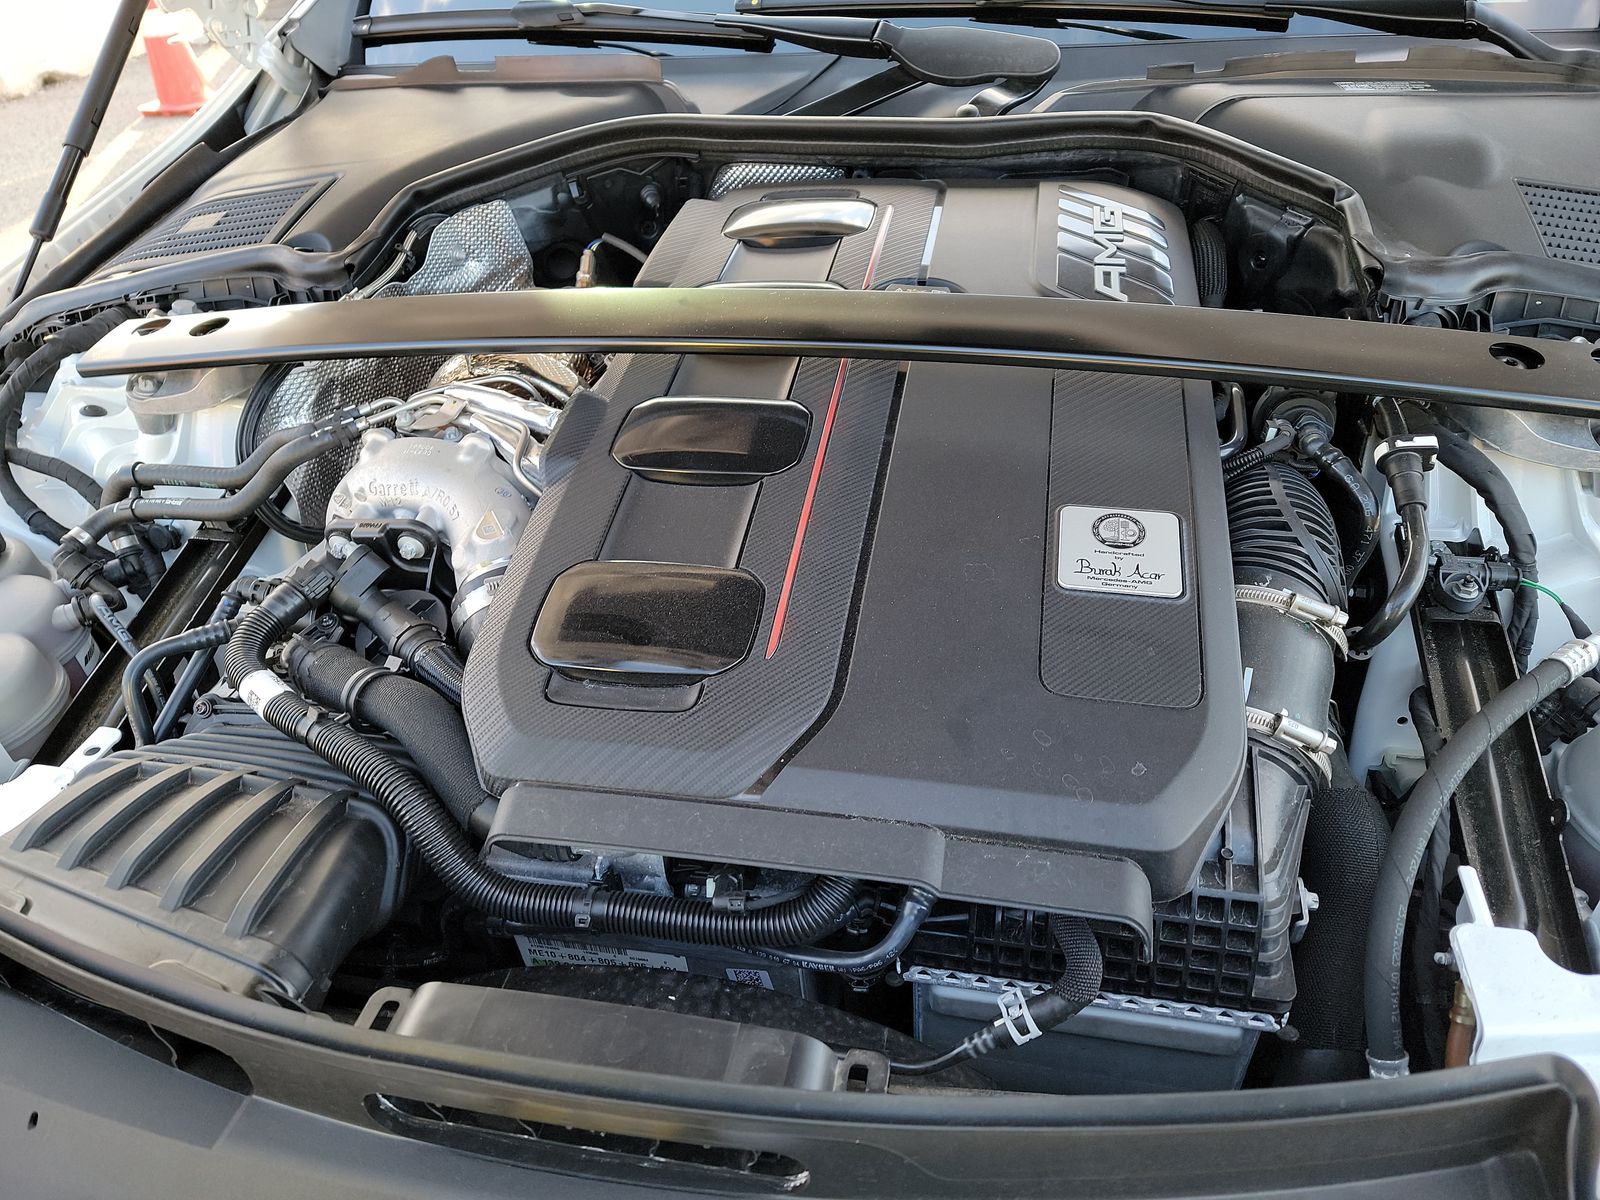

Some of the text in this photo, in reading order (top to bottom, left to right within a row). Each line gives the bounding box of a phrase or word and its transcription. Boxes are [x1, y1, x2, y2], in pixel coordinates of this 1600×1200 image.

[1093, 205, 1128, 302] AMG
[368, 478, 420, 498] Garrett
[1360, 494, 1374, 517] 206
[1361, 525, 1373, 545] 471
[1094, 549, 1145, 557] Handcrafted
[1352, 549, 1366, 563] 37
[1073, 558, 1166, 581] Burak Acar
[1086, 575, 1153, 585] Mercedes-AMG
[1101, 581, 1139, 590] Germany
[528, 948, 557, 958] ME10
[567, 953, 587, 962] 804
